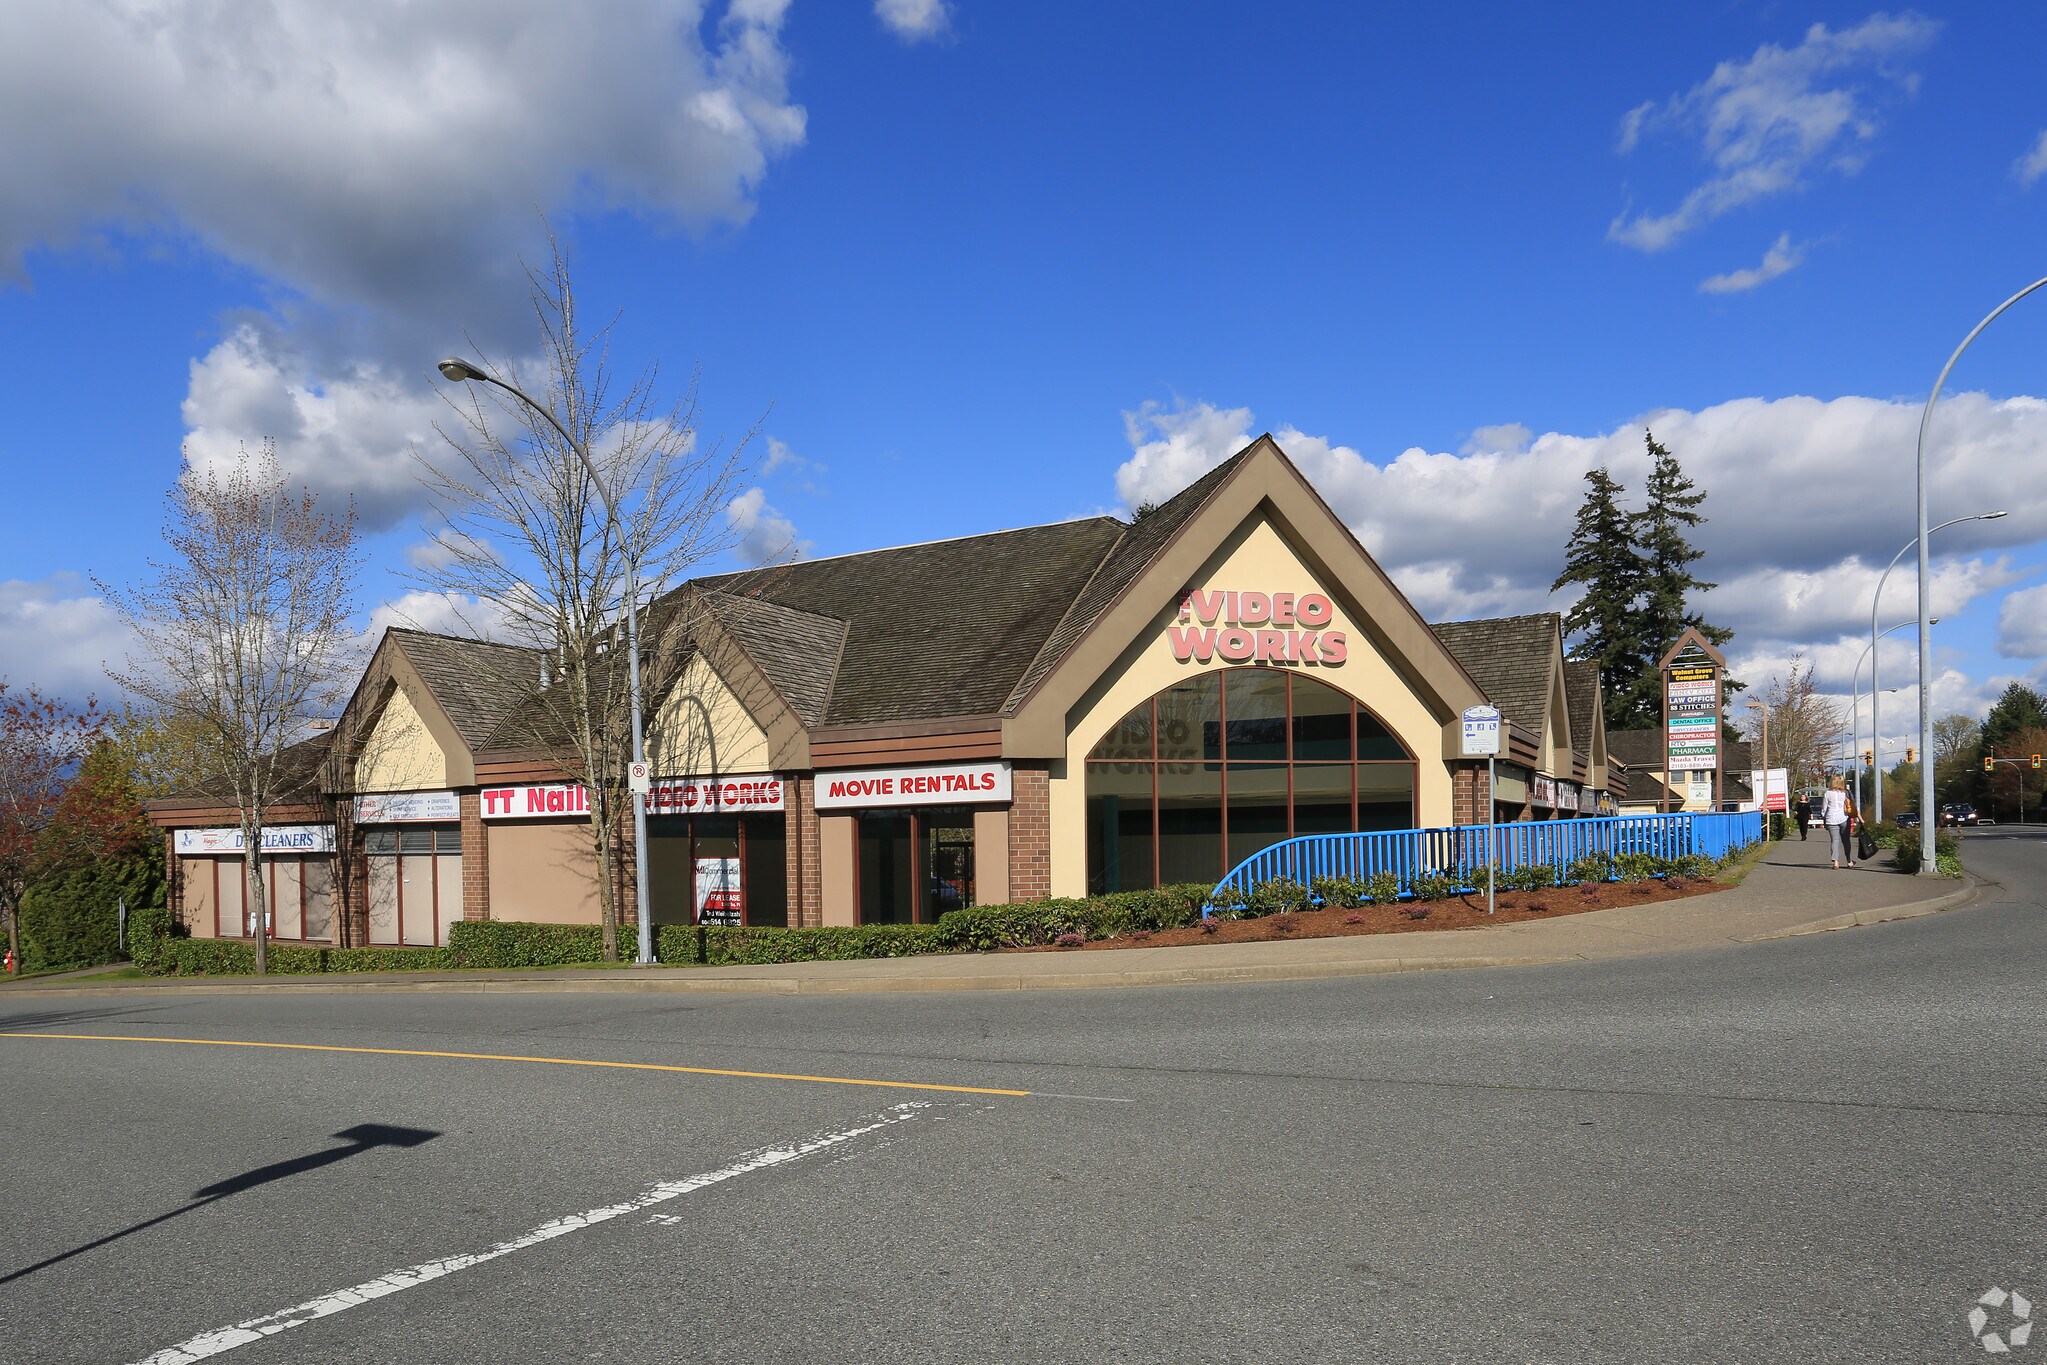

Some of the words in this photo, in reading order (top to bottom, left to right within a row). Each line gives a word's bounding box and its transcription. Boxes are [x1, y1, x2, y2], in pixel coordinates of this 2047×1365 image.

[1190, 589, 1333, 627] VIDEO
[1168, 626, 1348, 665] WORKS
[1672, 747, 1714, 755] PHARMACY
[703, 781, 781, 806] WORKS
[829, 778, 893, 798] MOVIE
[900, 772, 996, 794] RENTALS
[483, 789, 515, 815] TT
